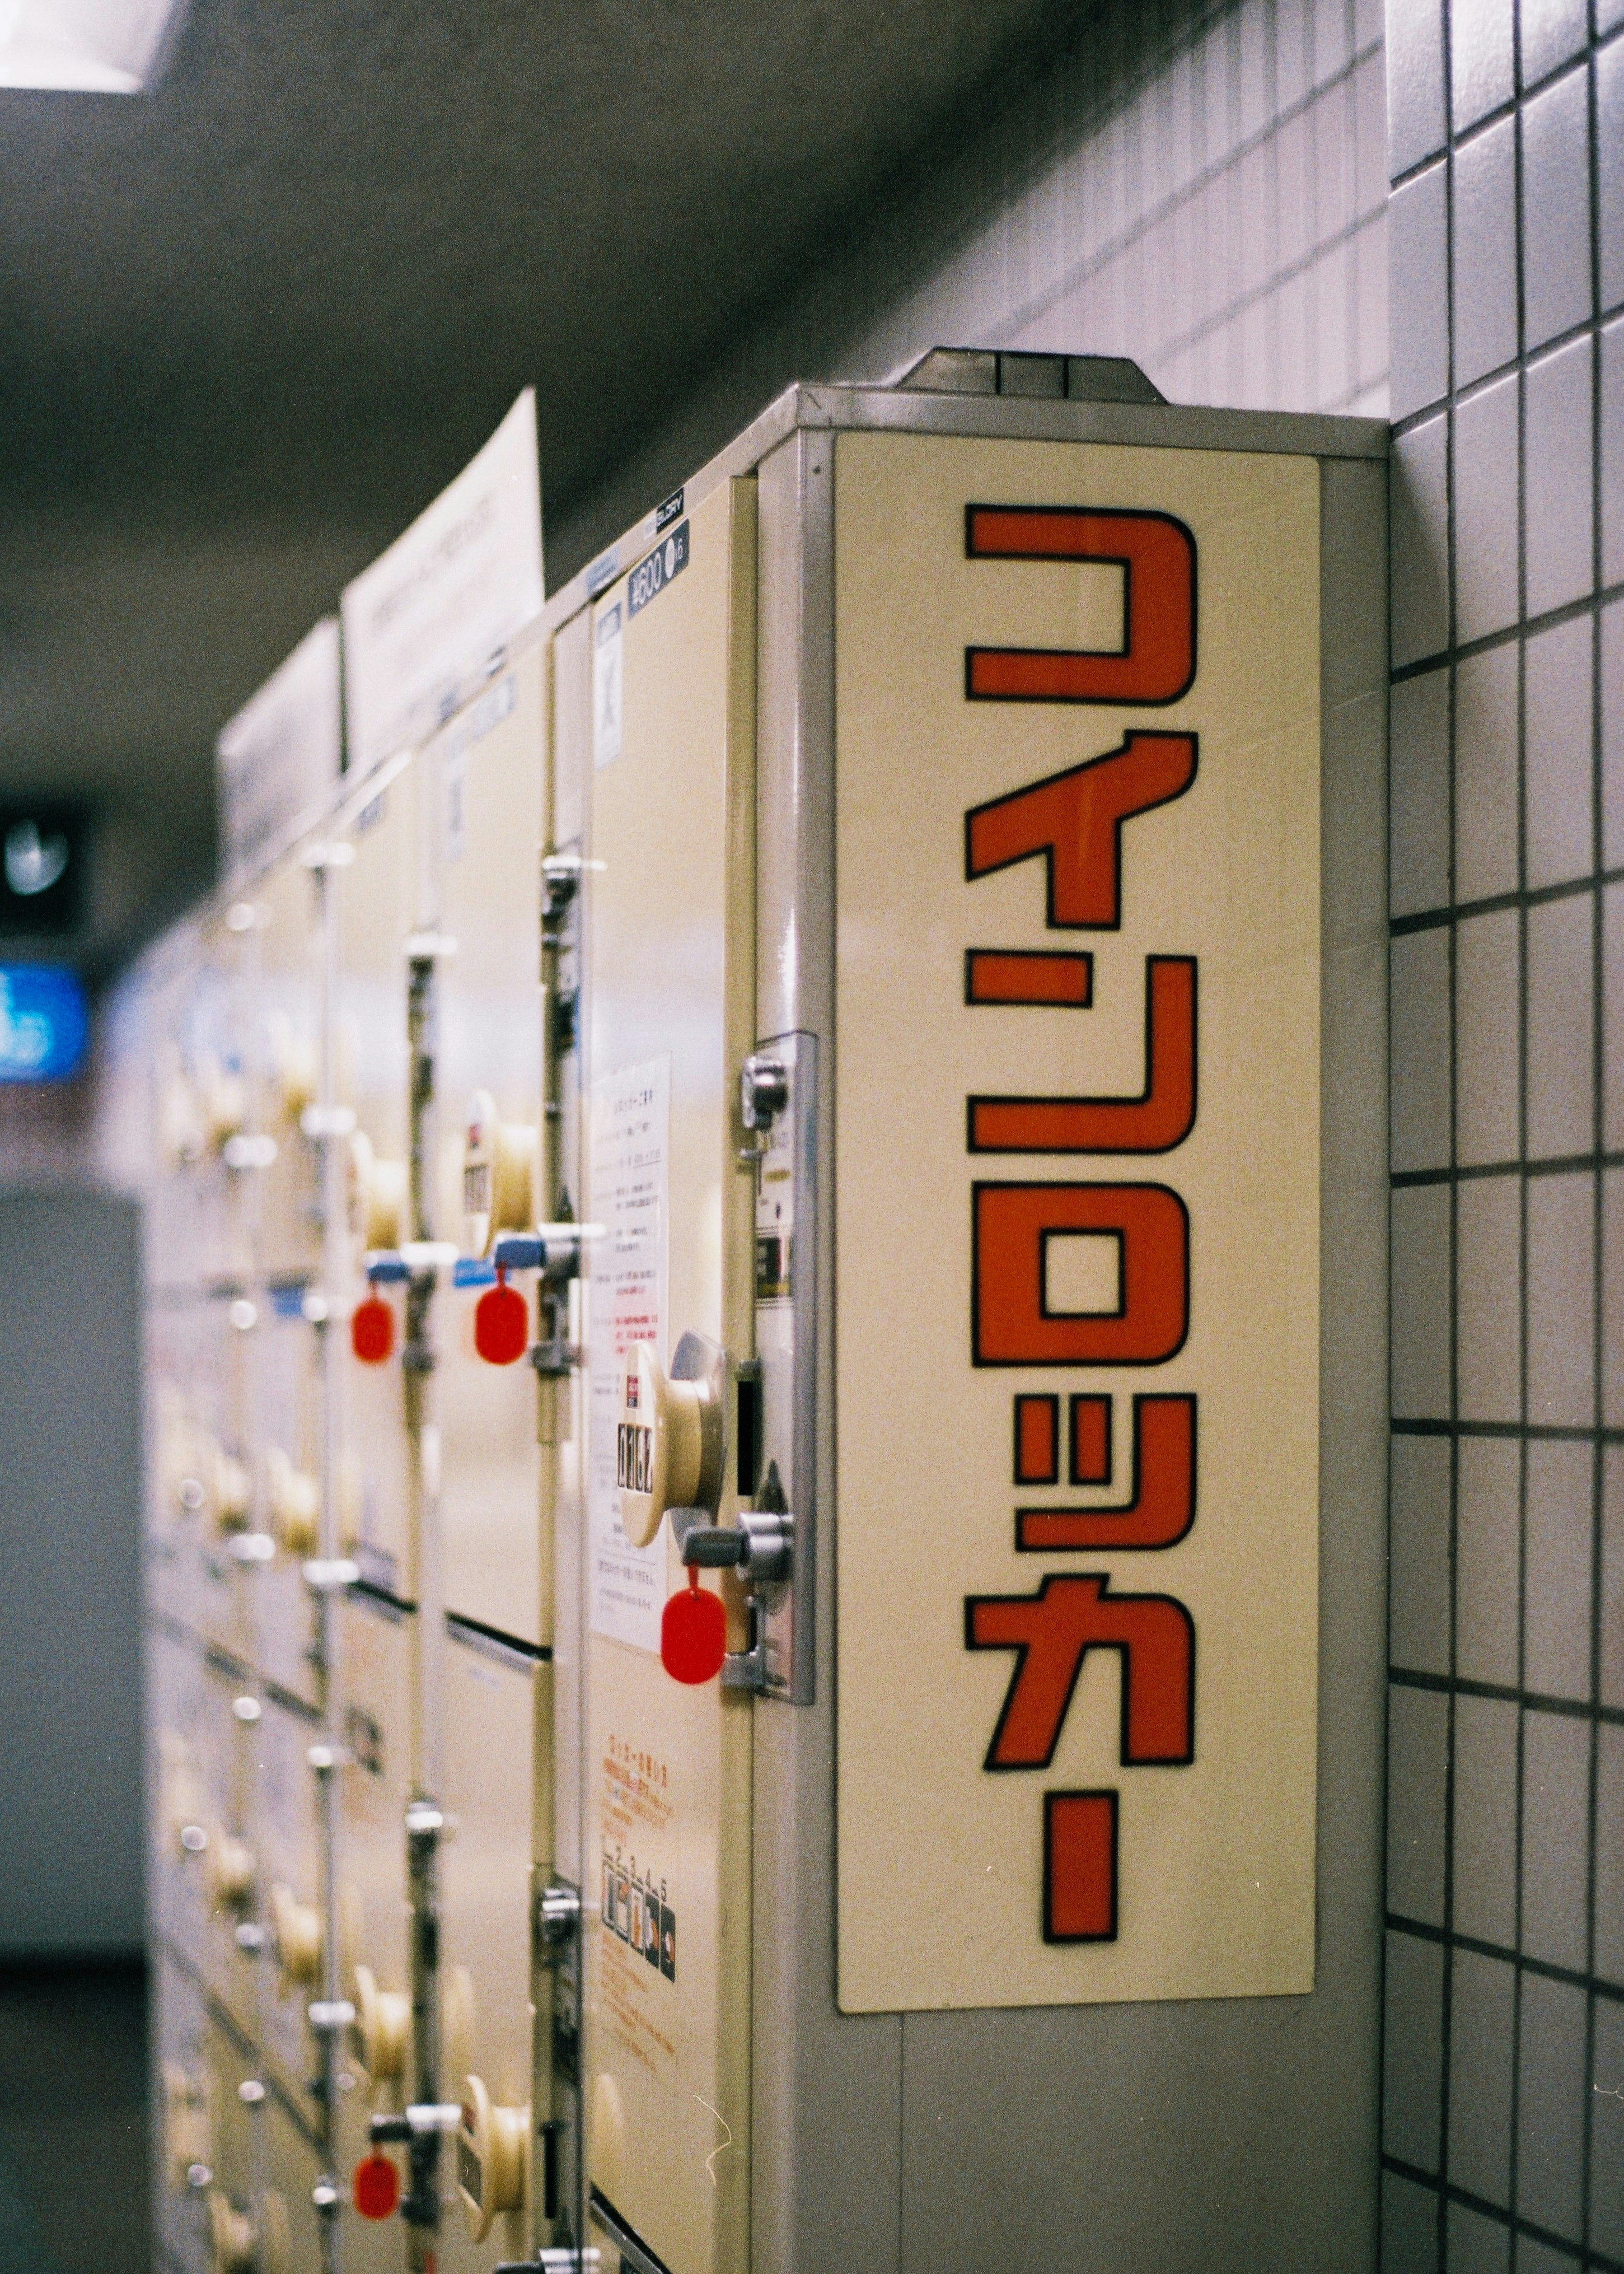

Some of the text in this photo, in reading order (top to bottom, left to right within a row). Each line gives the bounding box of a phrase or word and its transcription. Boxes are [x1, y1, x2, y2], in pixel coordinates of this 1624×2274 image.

[965, 503, 1199, 1947] コインロッカー
